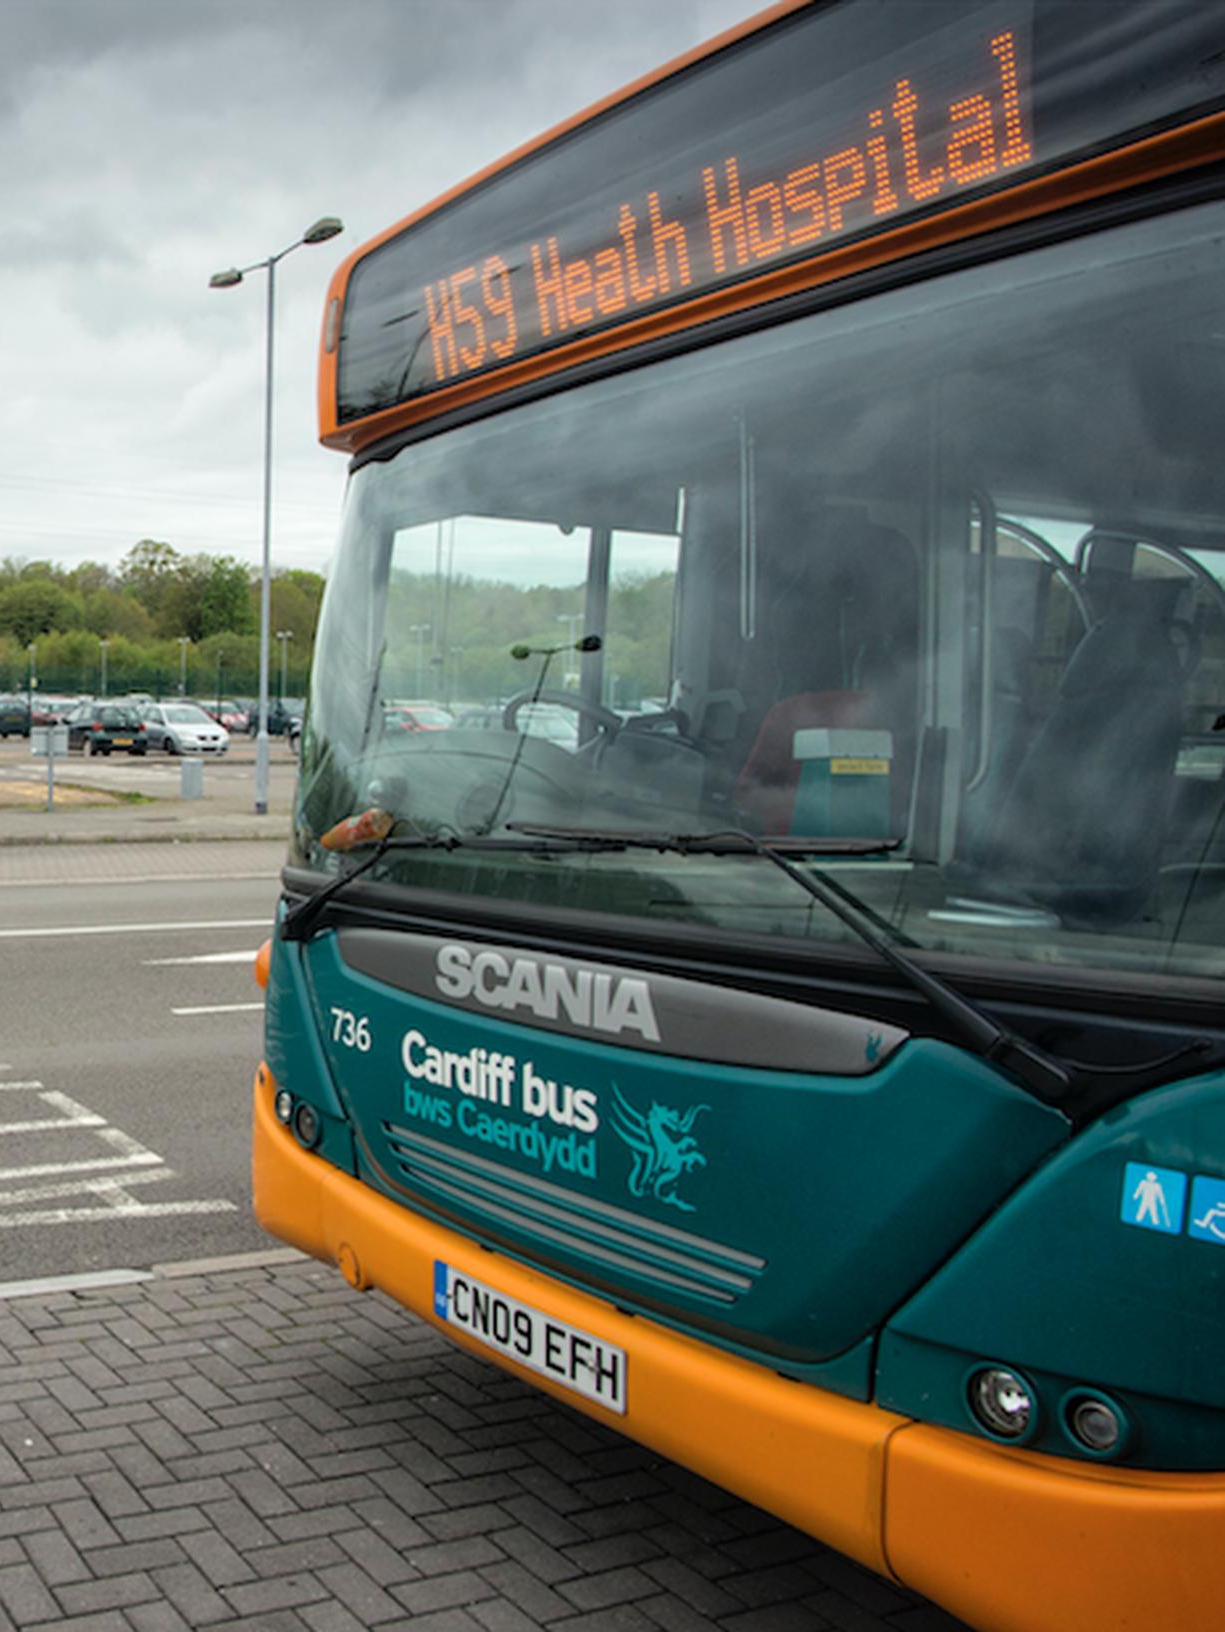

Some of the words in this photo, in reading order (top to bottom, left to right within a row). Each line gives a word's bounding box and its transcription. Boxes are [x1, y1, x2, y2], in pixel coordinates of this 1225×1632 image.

[530, 190, 691, 337] Heath
[701, 32, 1032, 274] Hospital
[329, 1006, 372, 1053] 736
[434, 943, 662, 1043] SCANIA
[400, 1028, 515, 1112] Cardiff
[521, 1058, 600, 1134] bus
[403, 1081, 453, 1130] bws
[455, 1094, 598, 1180] Caerdydd
[453, 1278, 533, 1357] CN09
[545, 1322, 618, 1401] EFH
